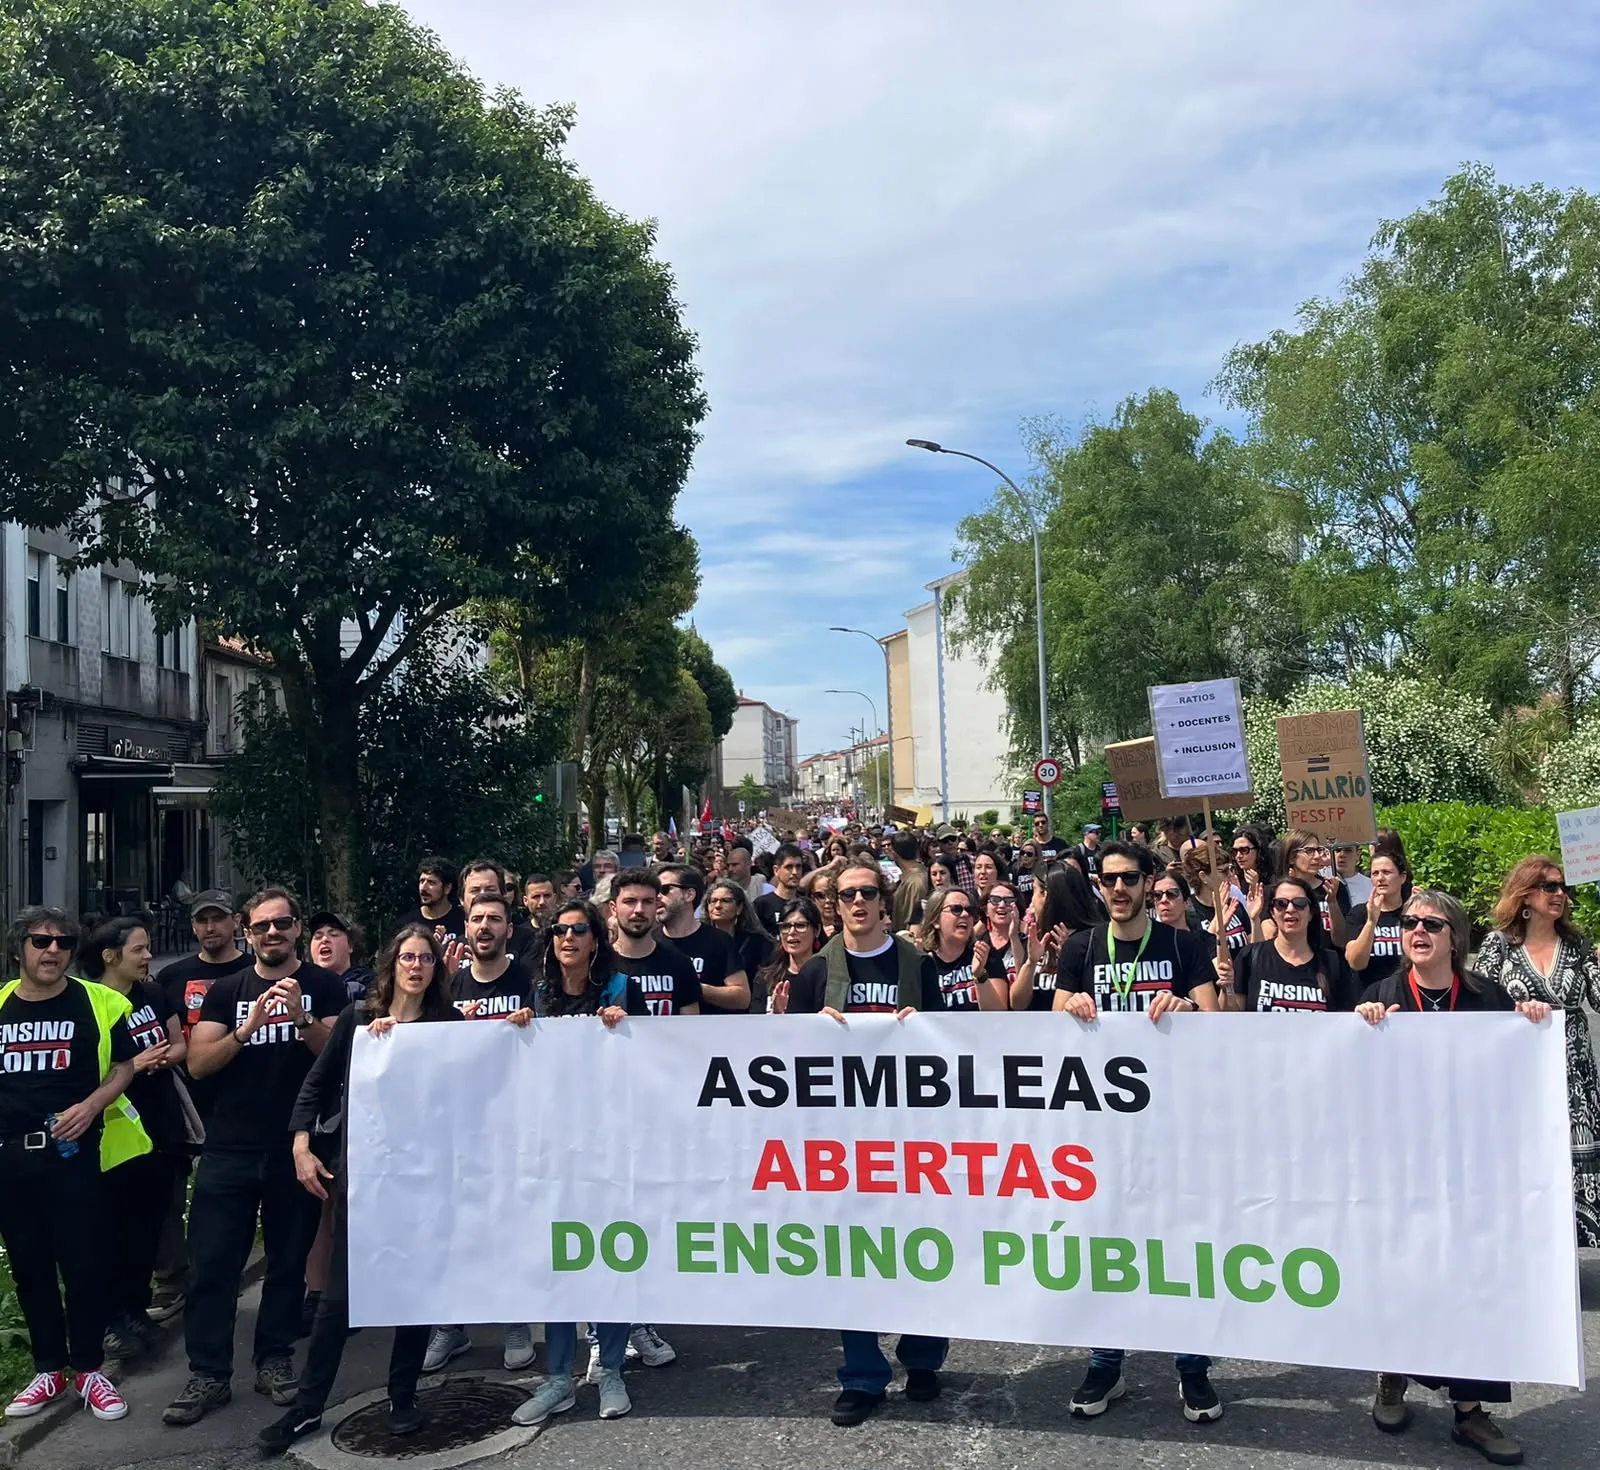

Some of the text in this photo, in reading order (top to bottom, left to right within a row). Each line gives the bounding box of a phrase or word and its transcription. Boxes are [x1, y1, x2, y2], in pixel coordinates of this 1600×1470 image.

[1178, 692, 1216, 704] RATIOS
[1178, 714, 1231, 728] DOCENTES
[1181, 741, 1237, 754] INCLUSIÓN
[1040, 768, 1055, 777] 30
[1177, 771, 1242, 785] BUROCRACIA
[1094, 960, 1174, 984] ENSINO
[1094, 984, 1110, 994] EN
[696, 1055, 1151, 1113] ASEMBLEAS
[752, 1139, 1097, 1202] ABERTAS
[551, 1220, 1340, 1308] DO ENSINO PÚBLICO
